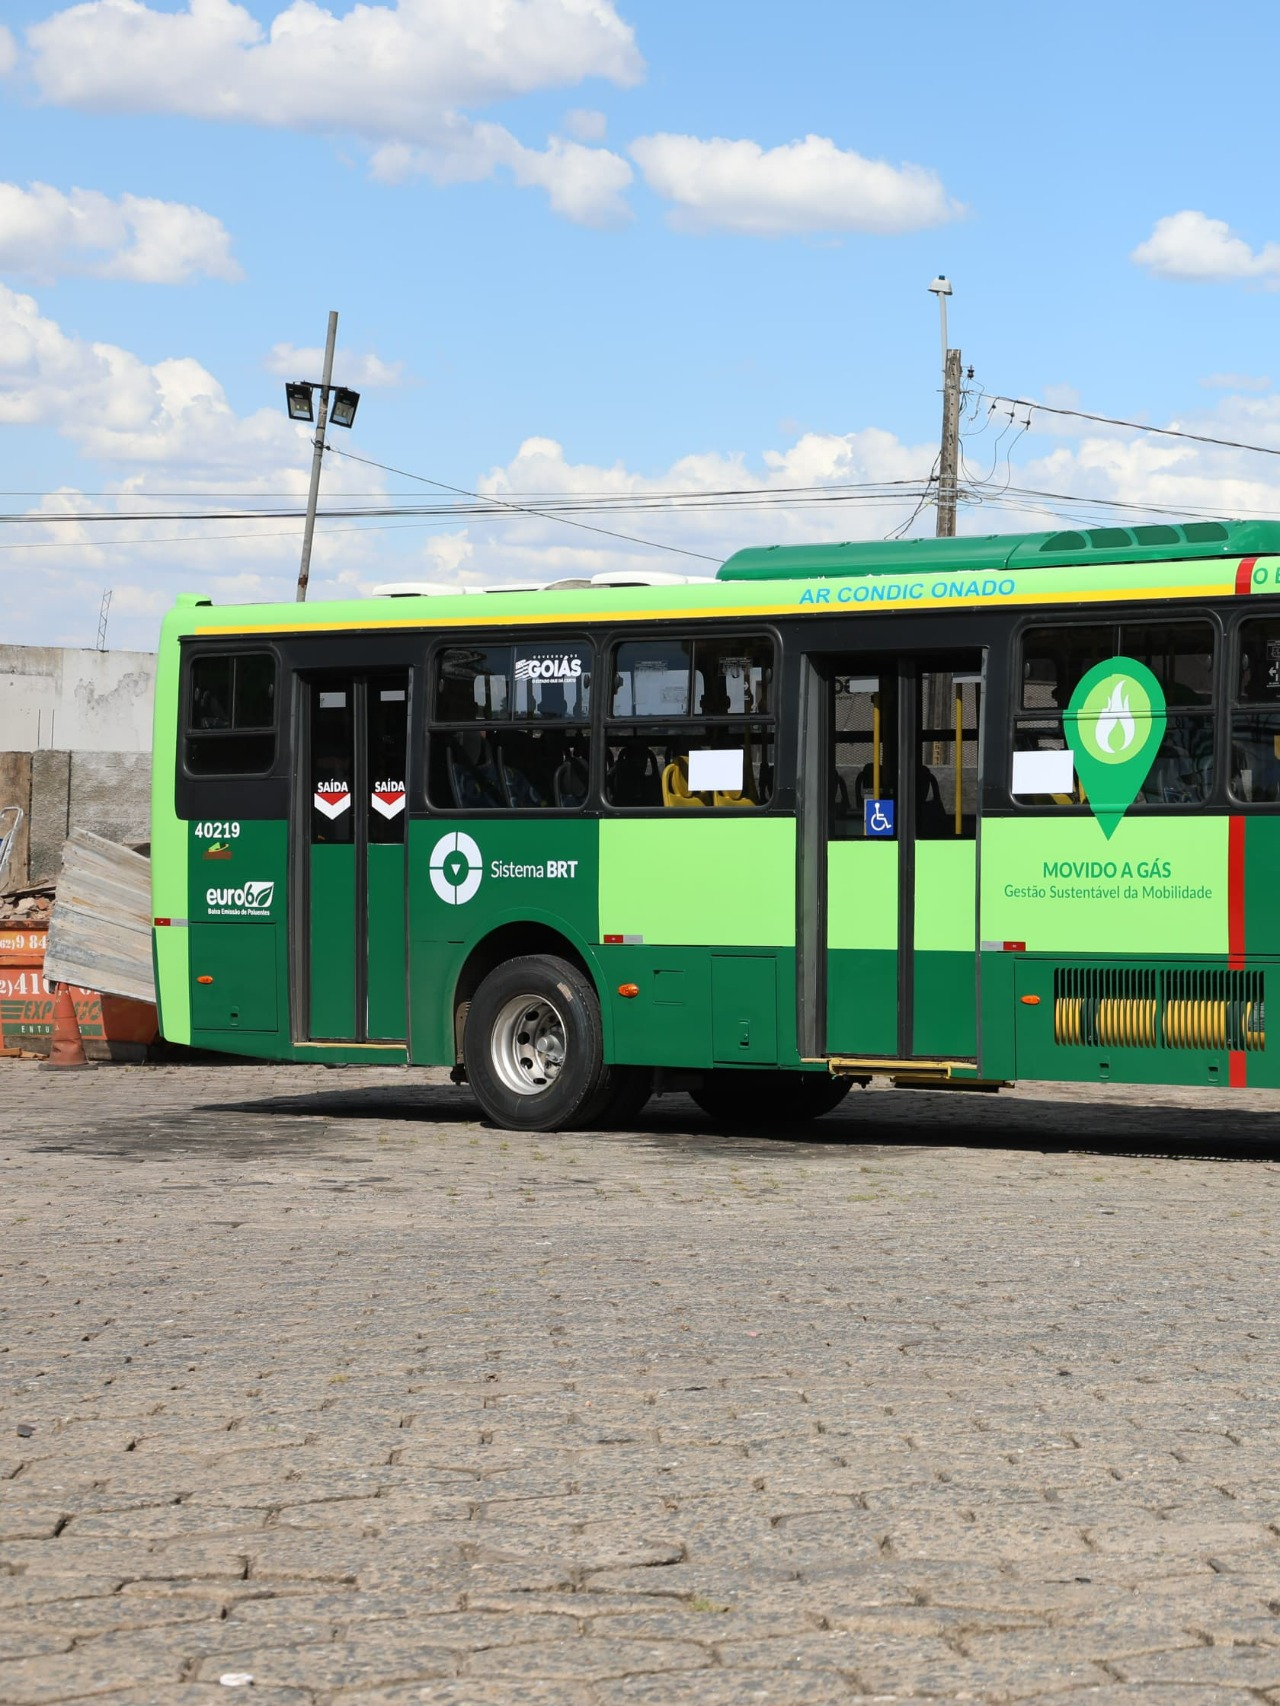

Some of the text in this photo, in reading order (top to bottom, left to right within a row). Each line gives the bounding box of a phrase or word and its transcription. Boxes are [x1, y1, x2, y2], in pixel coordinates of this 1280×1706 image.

[1252, 567, 1268, 585] O
[799, 588, 830, 604] AR
[528, 655, 582, 678] GOIÁS
[317, 778, 348, 793] SAÍDA
[375, 778, 405, 792] SAÍDA
[195, 822, 240, 839] 40219
[490, 860, 578, 878] Sistema BRT
[1043, 858, 1172, 879] MOVIDO A GÁS
[206, 882, 256, 907] euro6
[1004, 884, 1213, 899] Gestão Sustentável da Mobilidade
